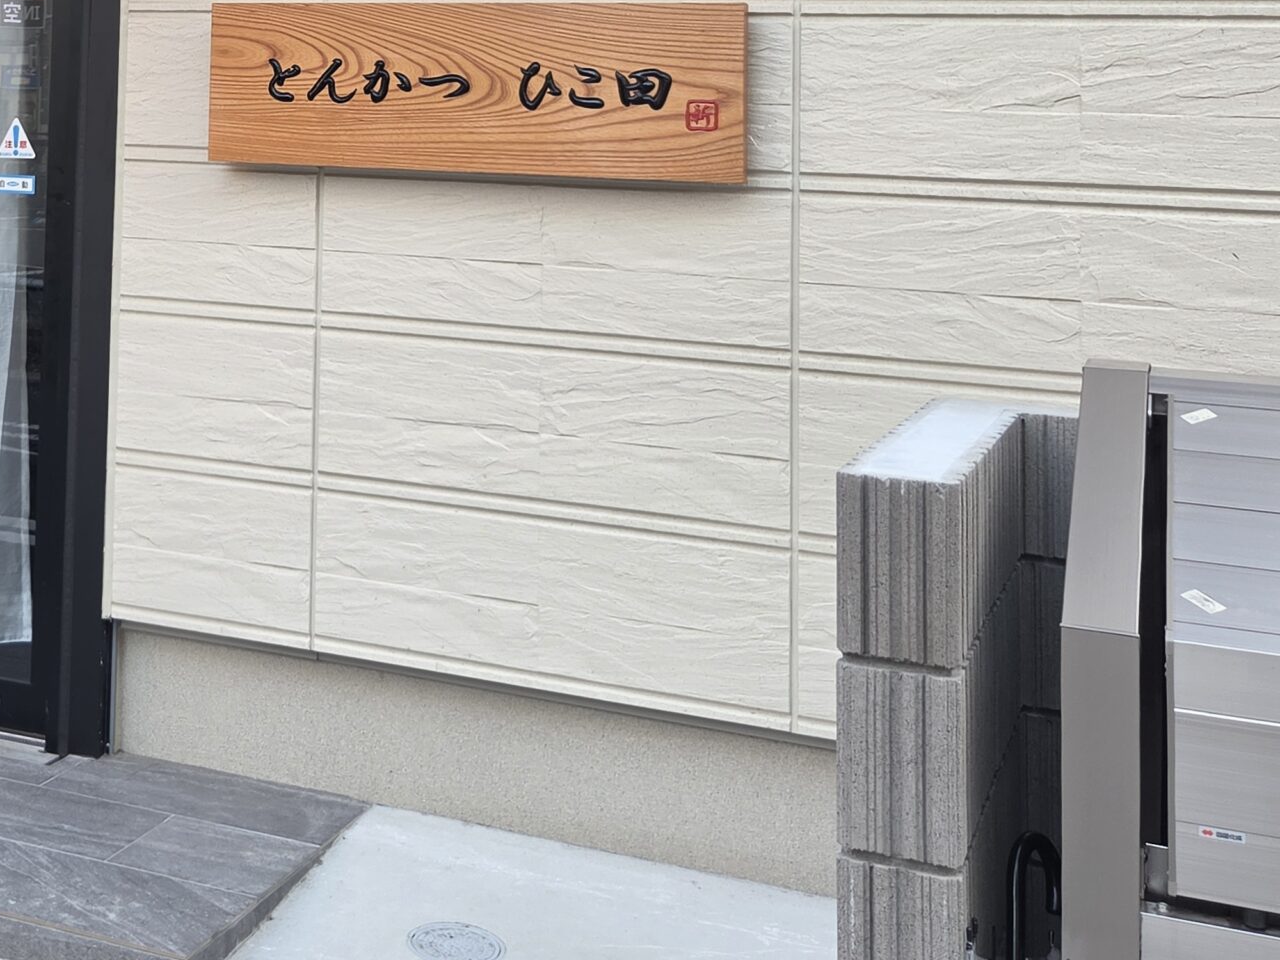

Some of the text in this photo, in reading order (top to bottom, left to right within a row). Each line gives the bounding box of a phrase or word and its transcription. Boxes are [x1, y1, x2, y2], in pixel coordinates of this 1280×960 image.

[266, 57, 673, 112] とんかつ ひこ田
